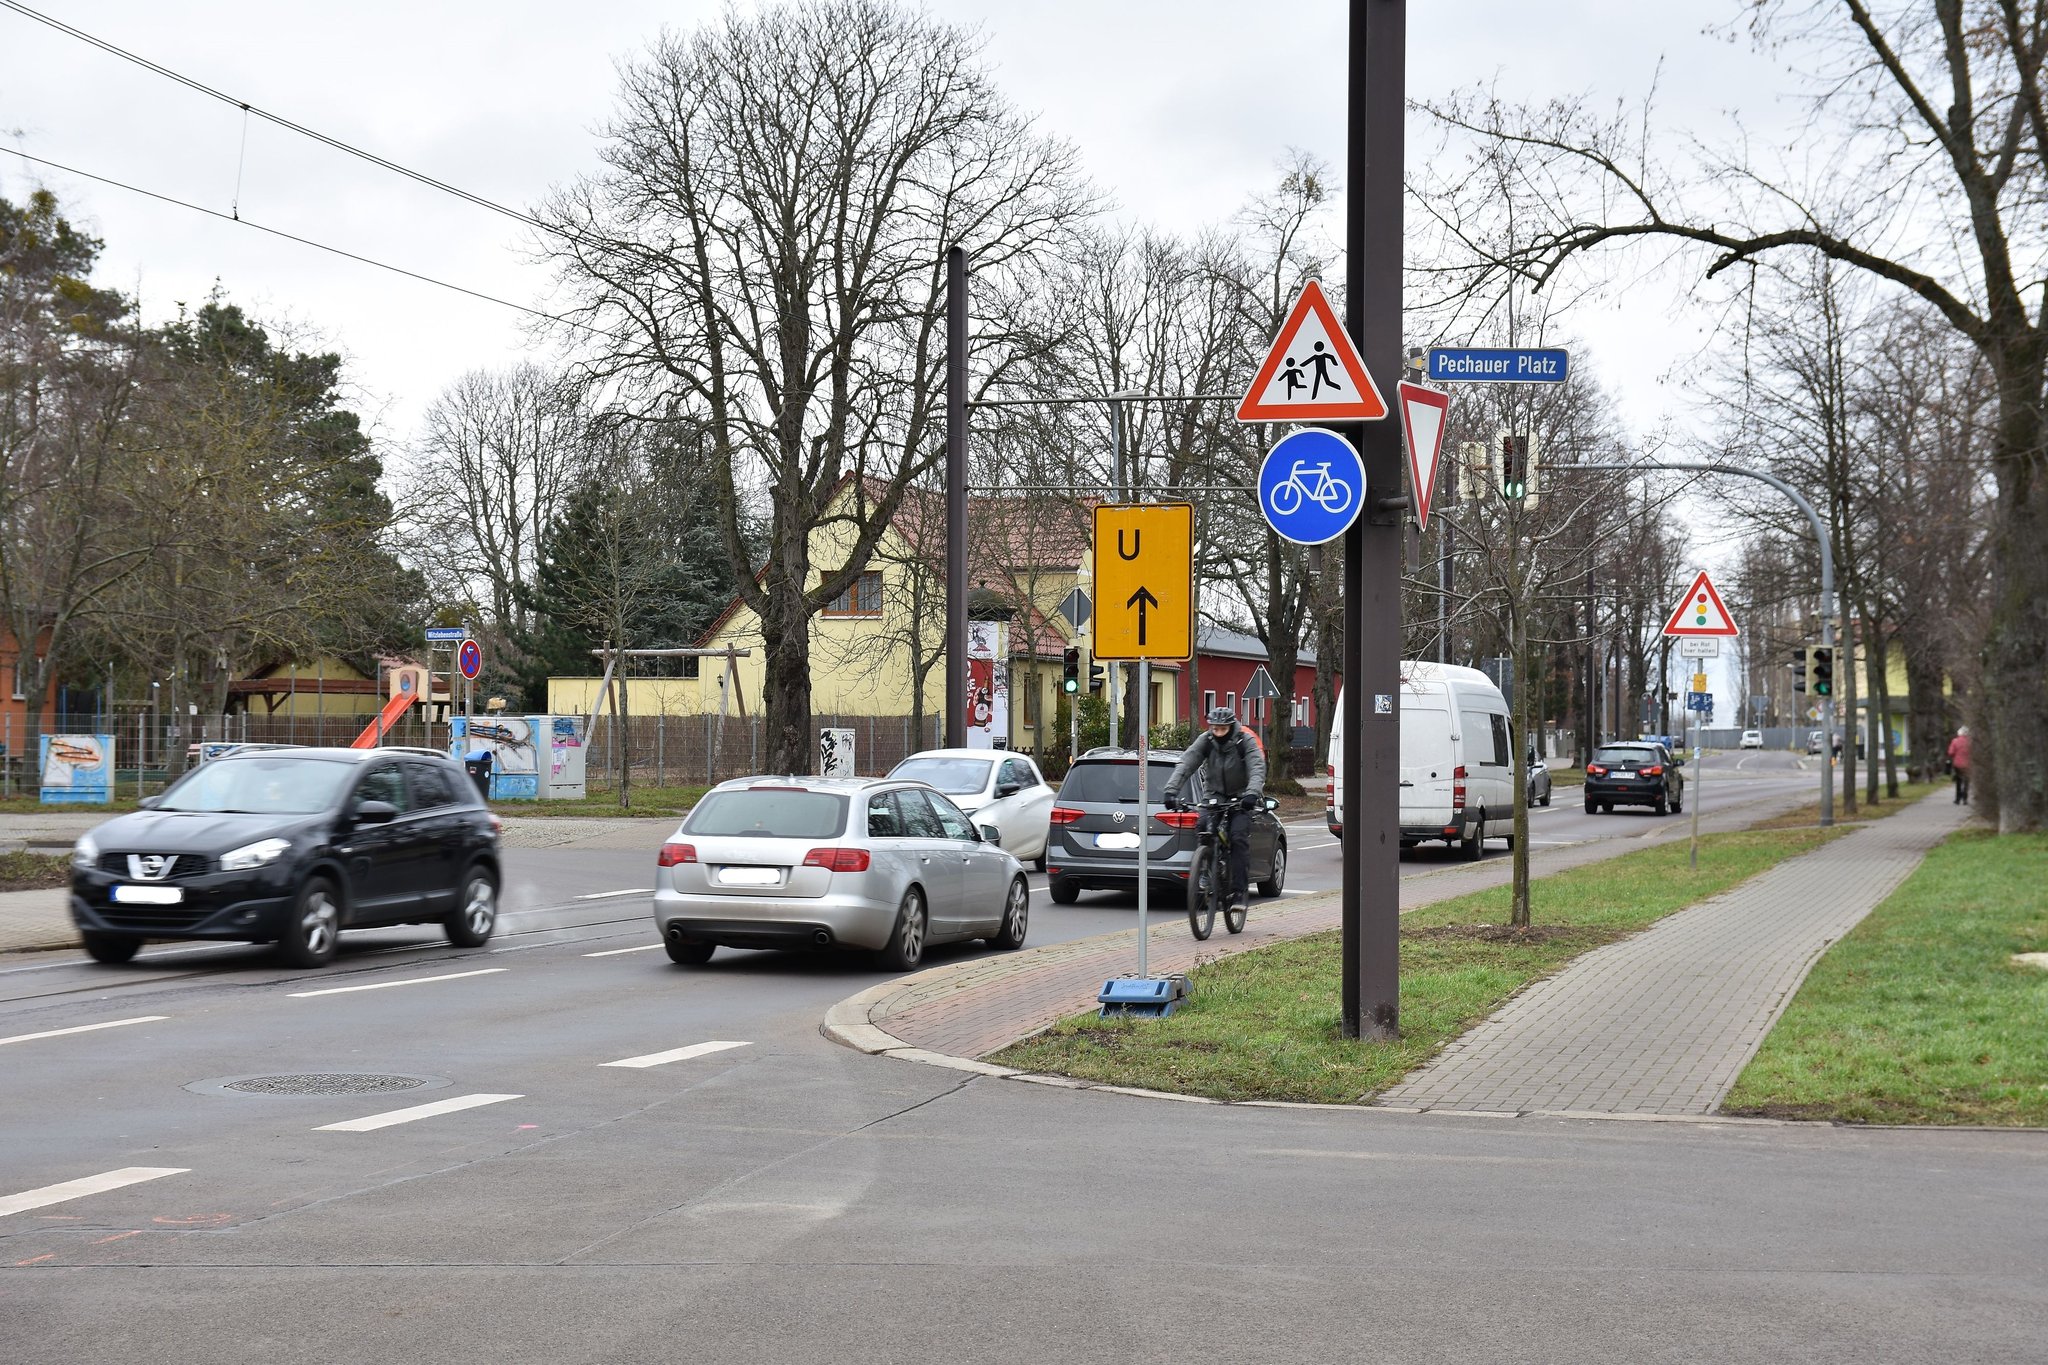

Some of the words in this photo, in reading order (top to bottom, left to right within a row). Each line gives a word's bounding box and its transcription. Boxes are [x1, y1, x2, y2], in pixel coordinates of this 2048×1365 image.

[1438, 354, 1511, 374] Pechauer
[1518, 355, 1557, 374] Platz
[1118, 529, 1140, 561] U
